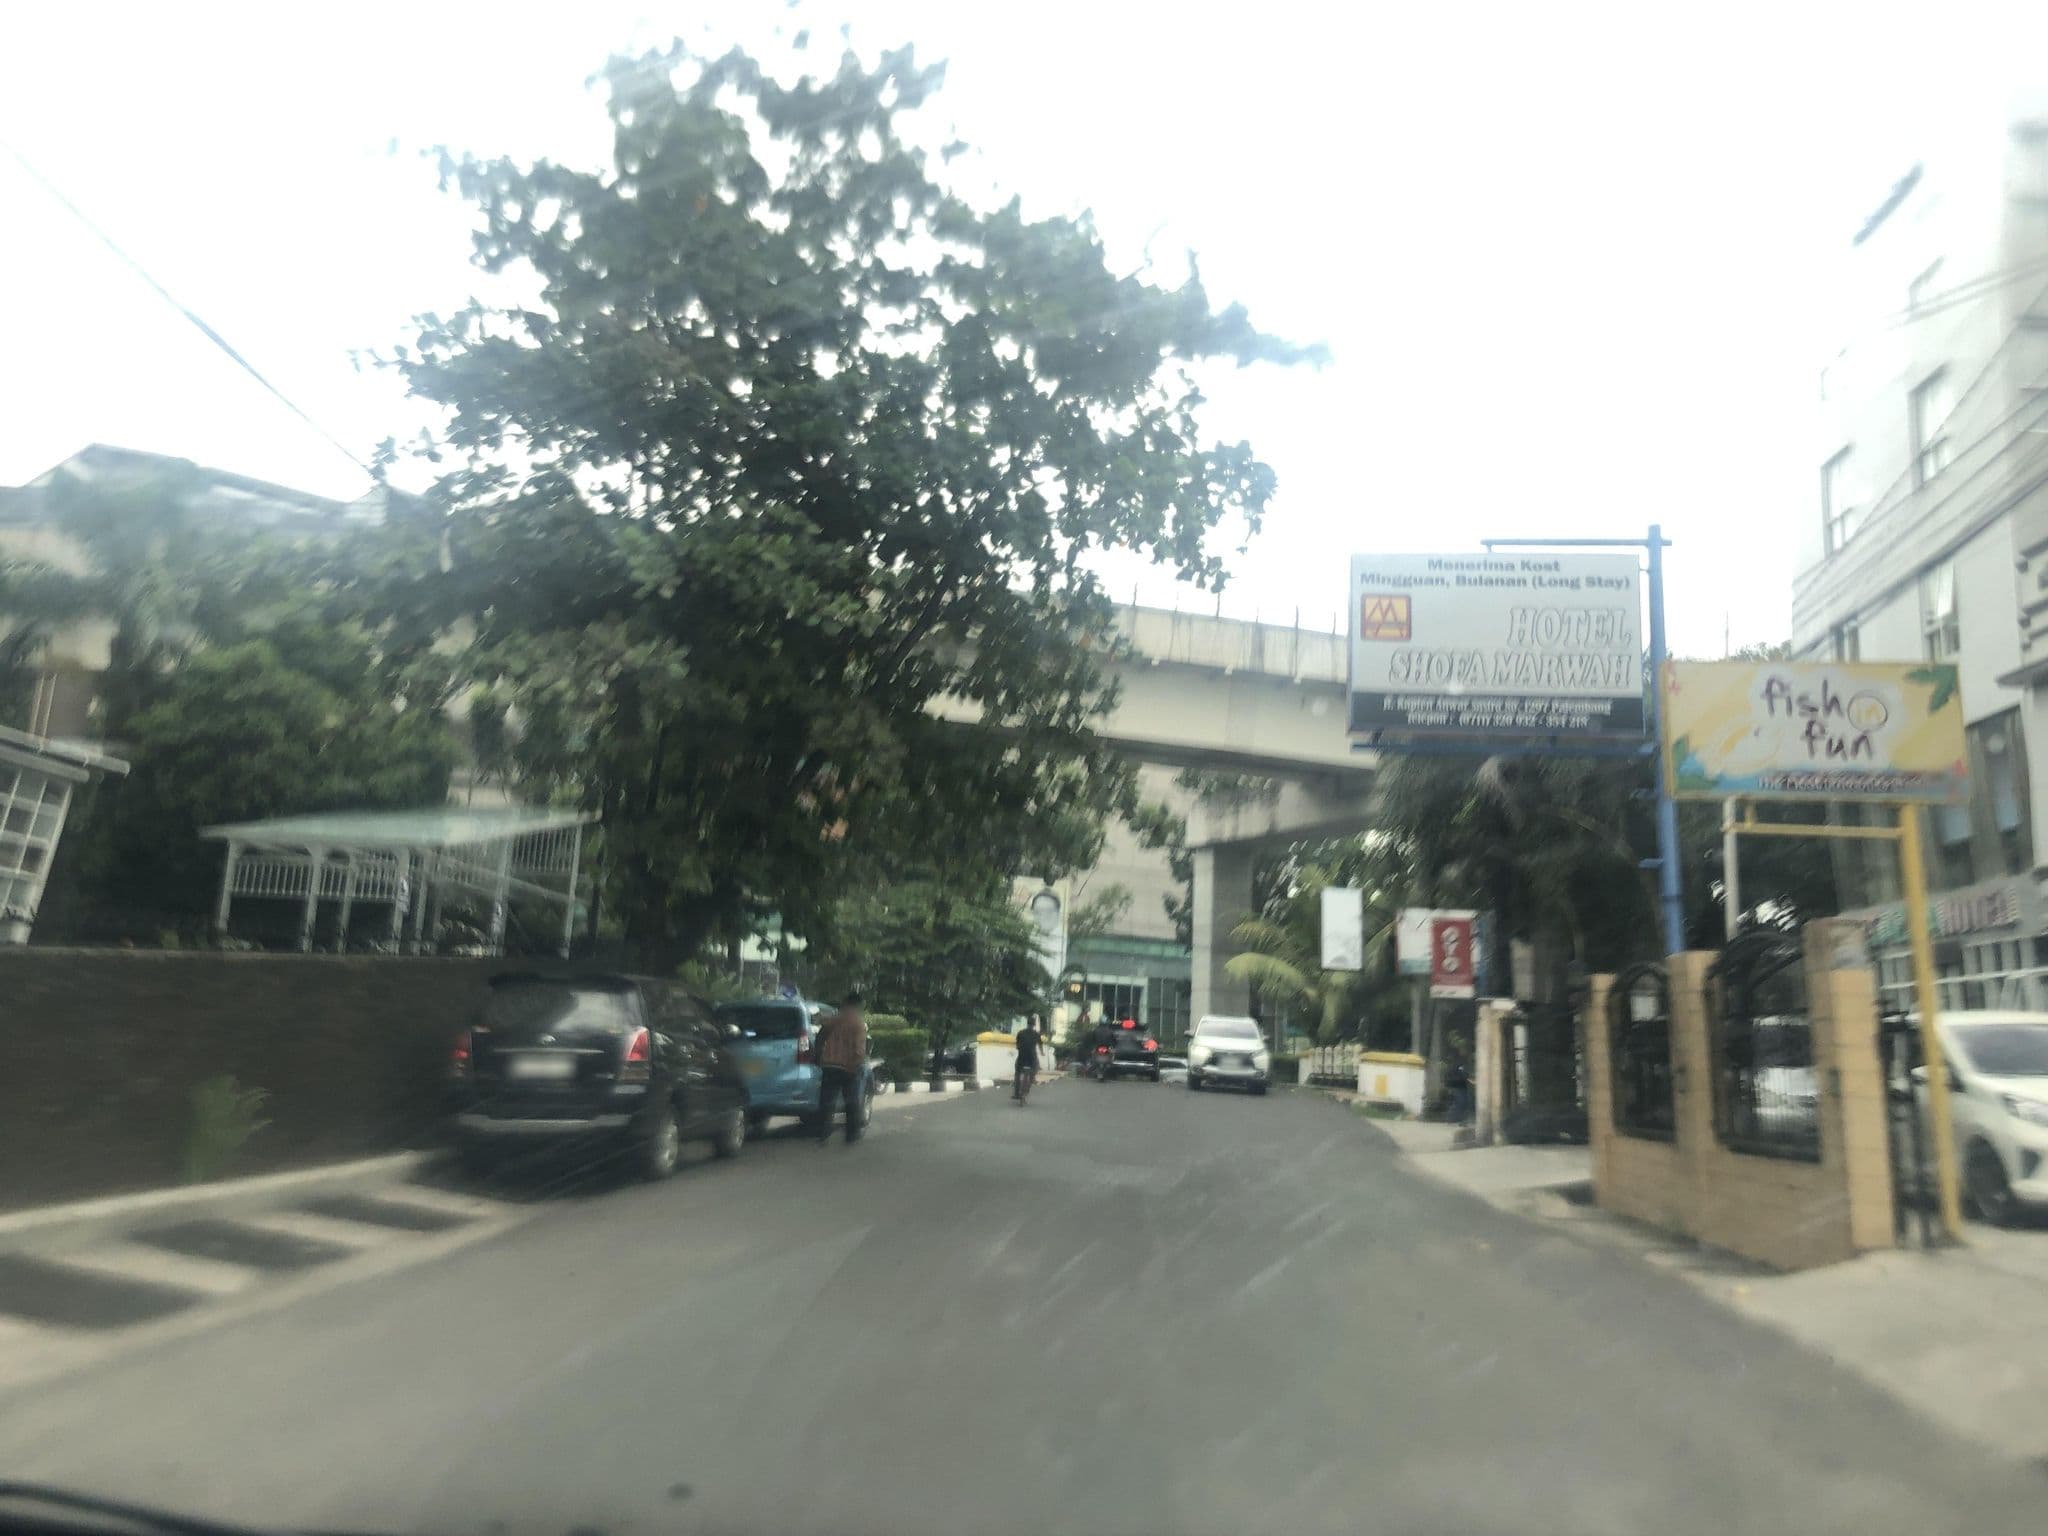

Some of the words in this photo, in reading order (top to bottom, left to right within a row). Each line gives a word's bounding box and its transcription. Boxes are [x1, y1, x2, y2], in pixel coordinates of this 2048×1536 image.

[1427, 558, 1515, 572] Menerima
[1520, 559, 1560, 572] Kost
[1455, 575, 1527, 588] Bulanan
[1531, 576, 1581, 591] (Long
[1585, 577, 1630, 590] Stay)
[1506, 607, 1632, 648] HOTEL
[1389, 650, 1485, 685] SHOFA
[1493, 651, 1632, 688] MARWAH
[1761, 677, 1844, 718] fish
[1804, 720, 1873, 760] fun
